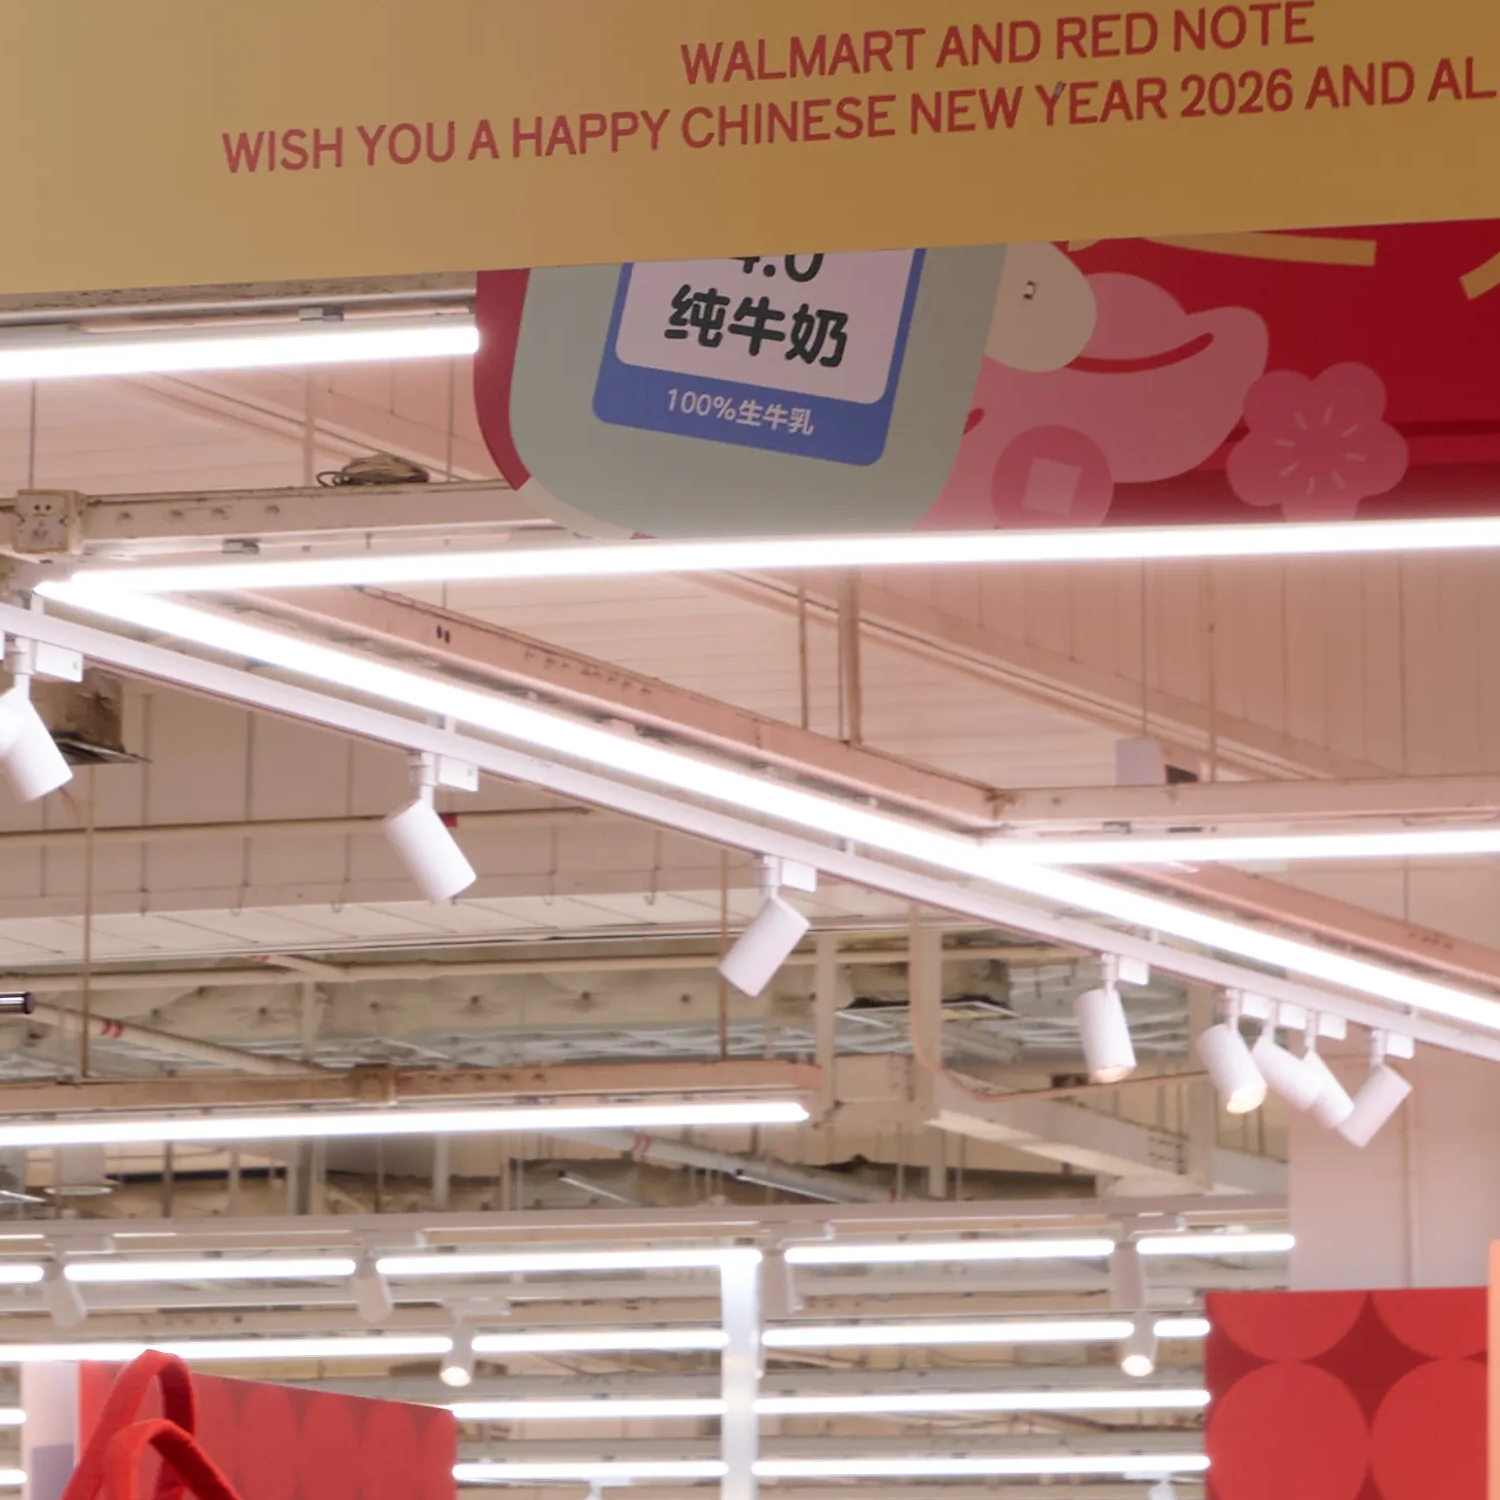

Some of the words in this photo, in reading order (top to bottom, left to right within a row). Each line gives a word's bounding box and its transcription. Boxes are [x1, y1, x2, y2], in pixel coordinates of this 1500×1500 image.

[681, 28, 926, 85] WALMART
[935, 20, 1042, 70] AND
[1056, 11, 1159, 60] RED
[1173, 0, 1316, 53] NOTE
[222, 126, 344, 174] WISH
[356, 120, 456, 167] YOU
[467, 119, 501, 162] A
[512, 109, 671, 158] HAPPY
[681, 94, 897, 149] CHINESE
[910, 86, 1025, 136] NEW
[1040, 77, 1169, 128] YEAR
[1180, 68, 1294, 119] 2026
[1305, 61, 1415, 110] AND
[663, 283, 849, 368] 纯牛奶
[667, 388, 815, 436] 100%生牛乳
